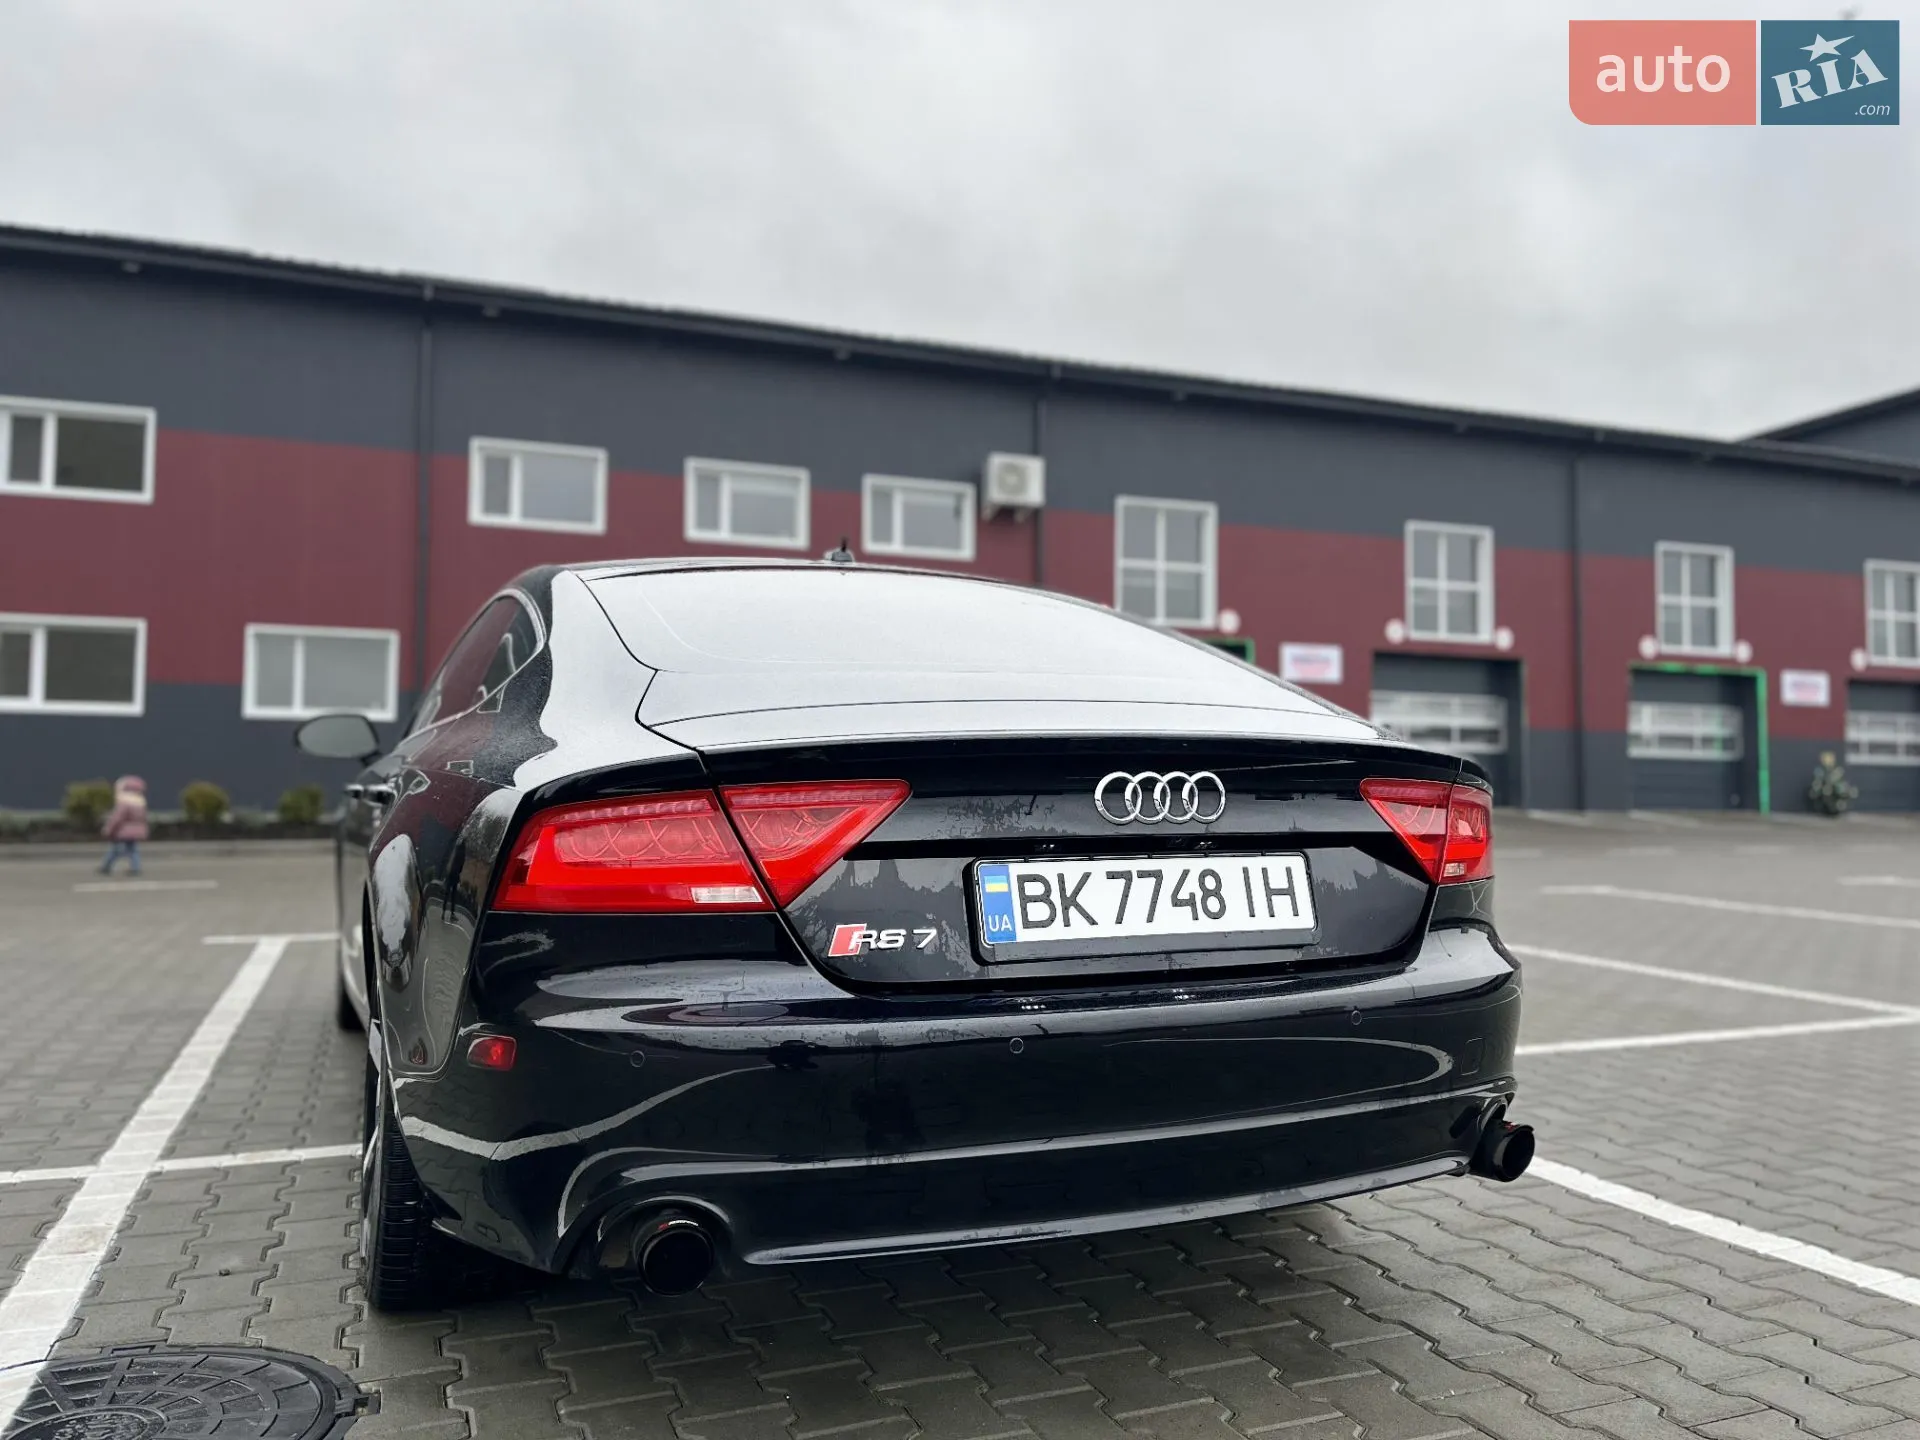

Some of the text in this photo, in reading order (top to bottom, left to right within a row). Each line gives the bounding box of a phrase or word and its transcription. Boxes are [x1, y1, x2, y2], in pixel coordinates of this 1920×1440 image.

[1016, 866, 1299, 930] BK 7748 IH
[985, 914, 1013, 933] UA
[912, 928, 937, 949] 7
